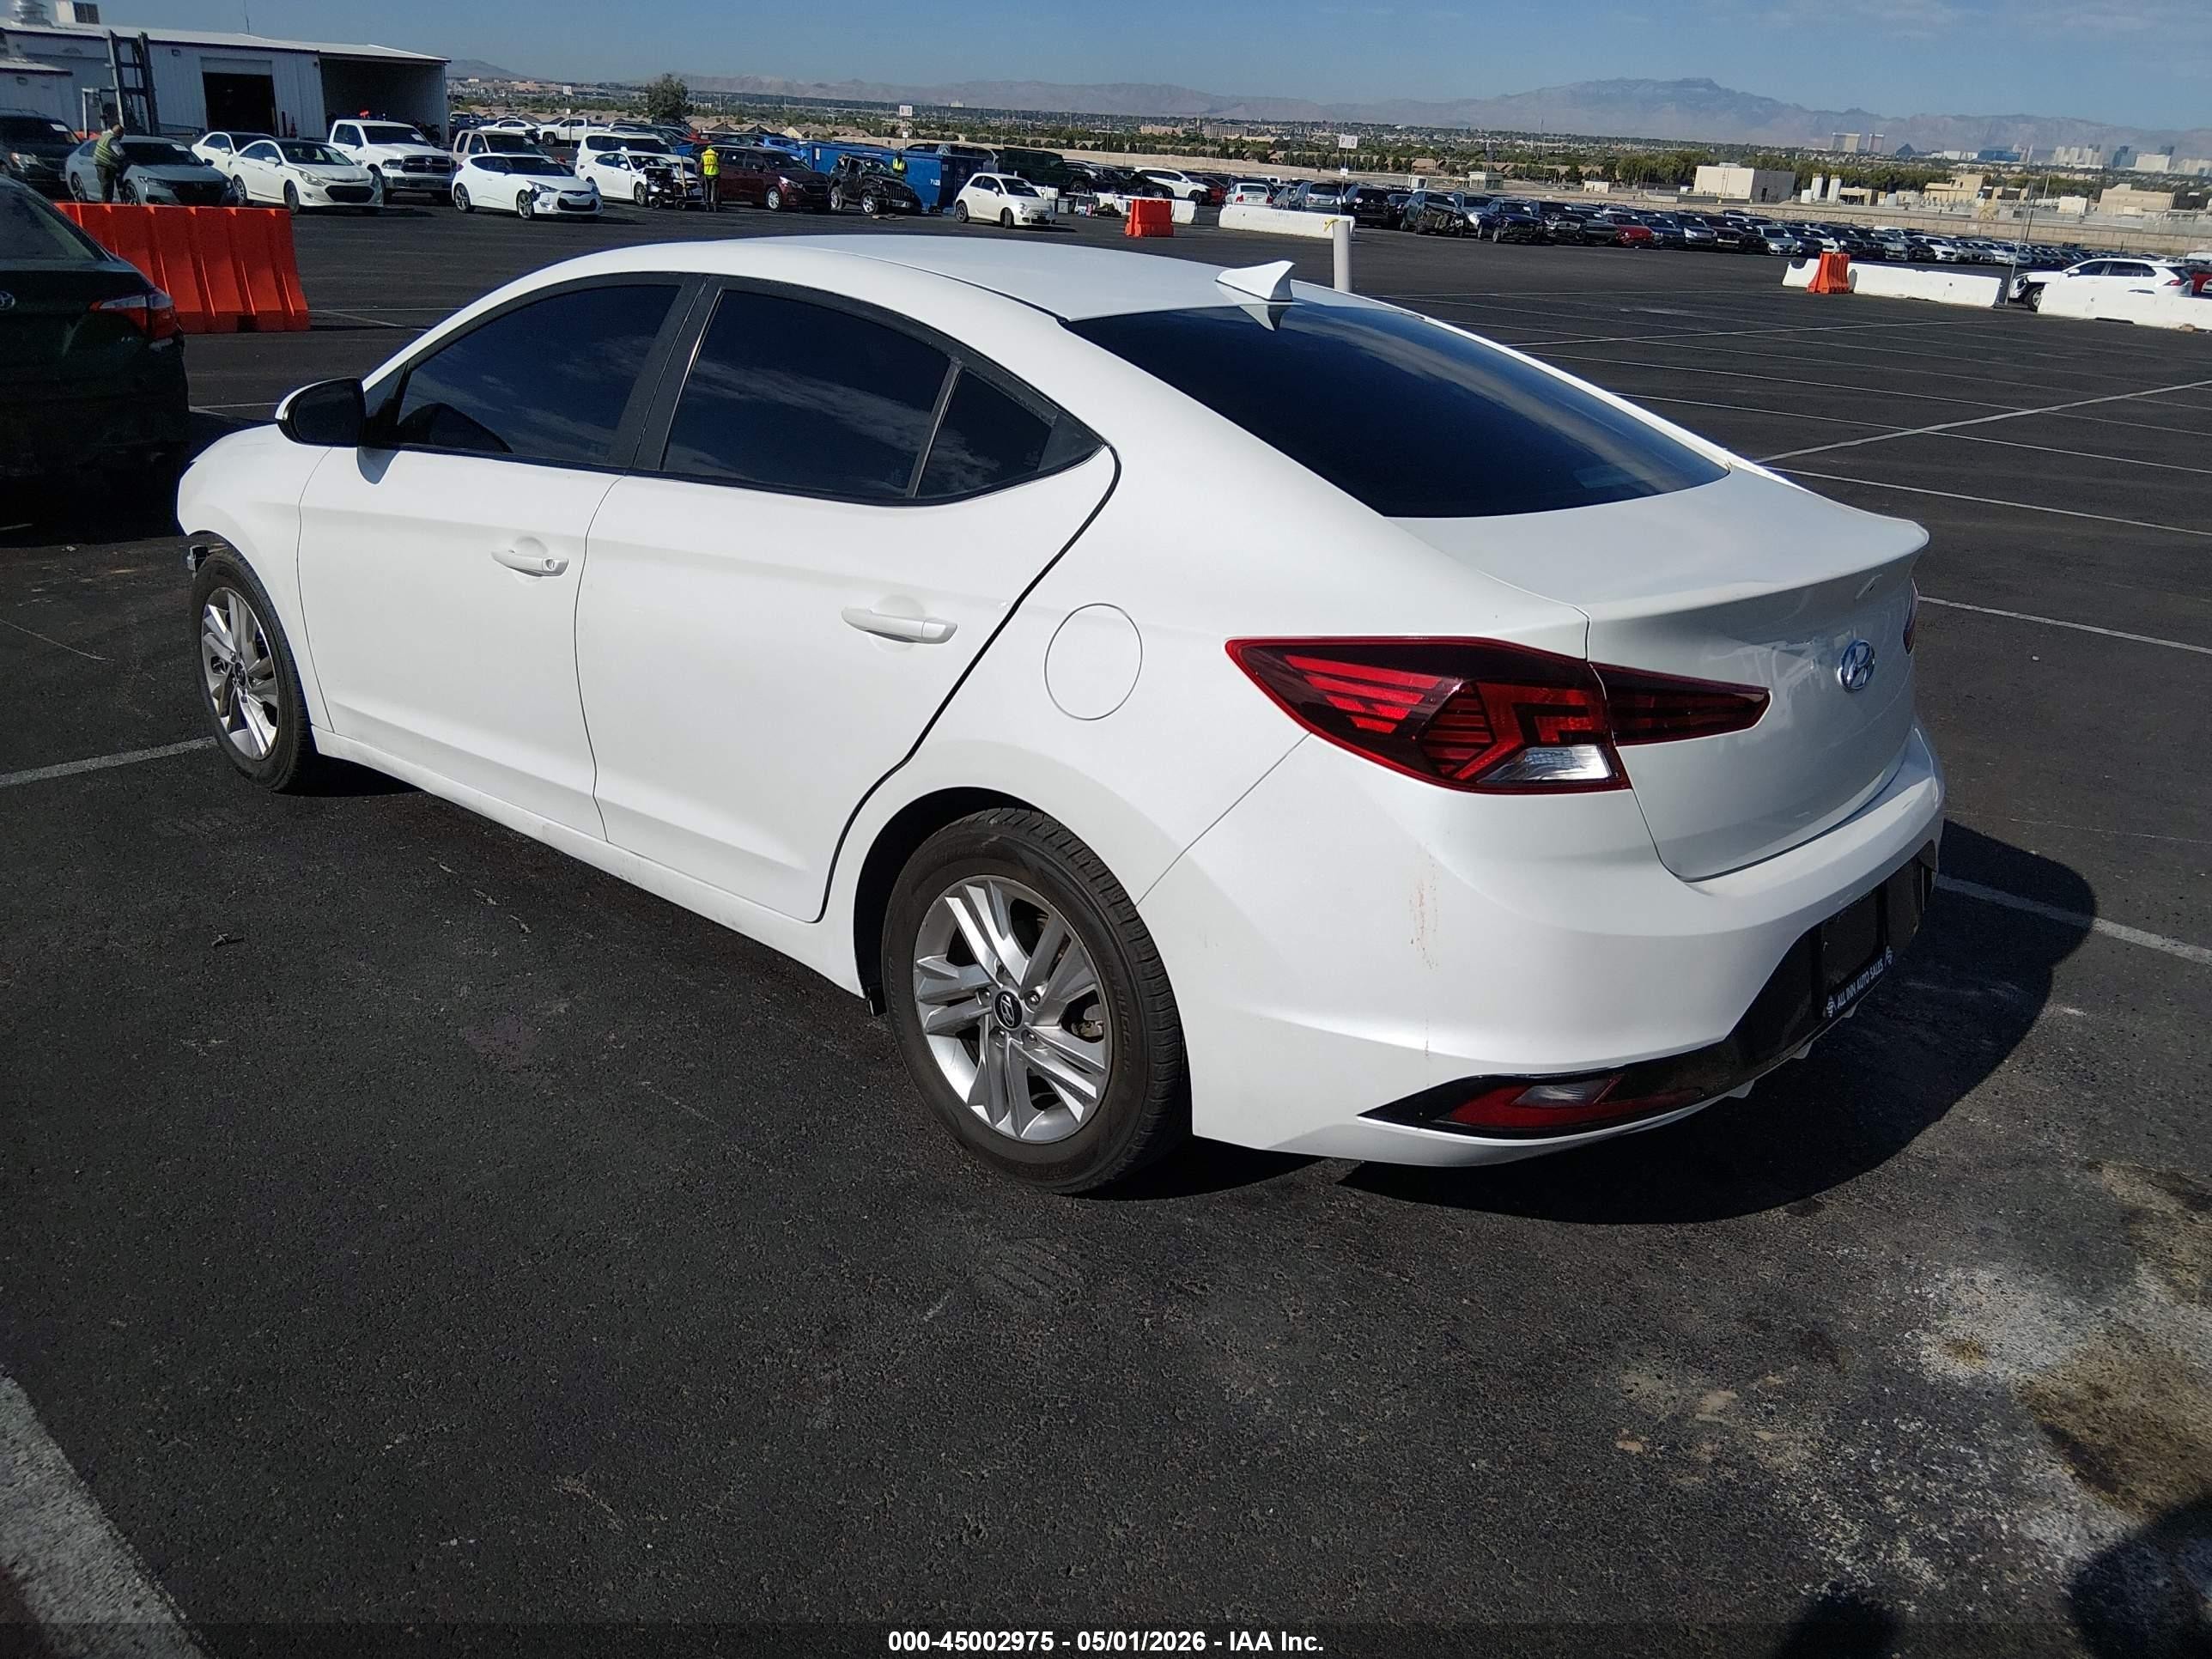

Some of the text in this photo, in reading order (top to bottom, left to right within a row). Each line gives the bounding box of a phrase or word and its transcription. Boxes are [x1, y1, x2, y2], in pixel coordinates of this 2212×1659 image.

[1837, 990, 1847, 1009] ALL
[1856, 969, 1870, 993] AUTO
[1869, 957, 1884, 981] SALES
